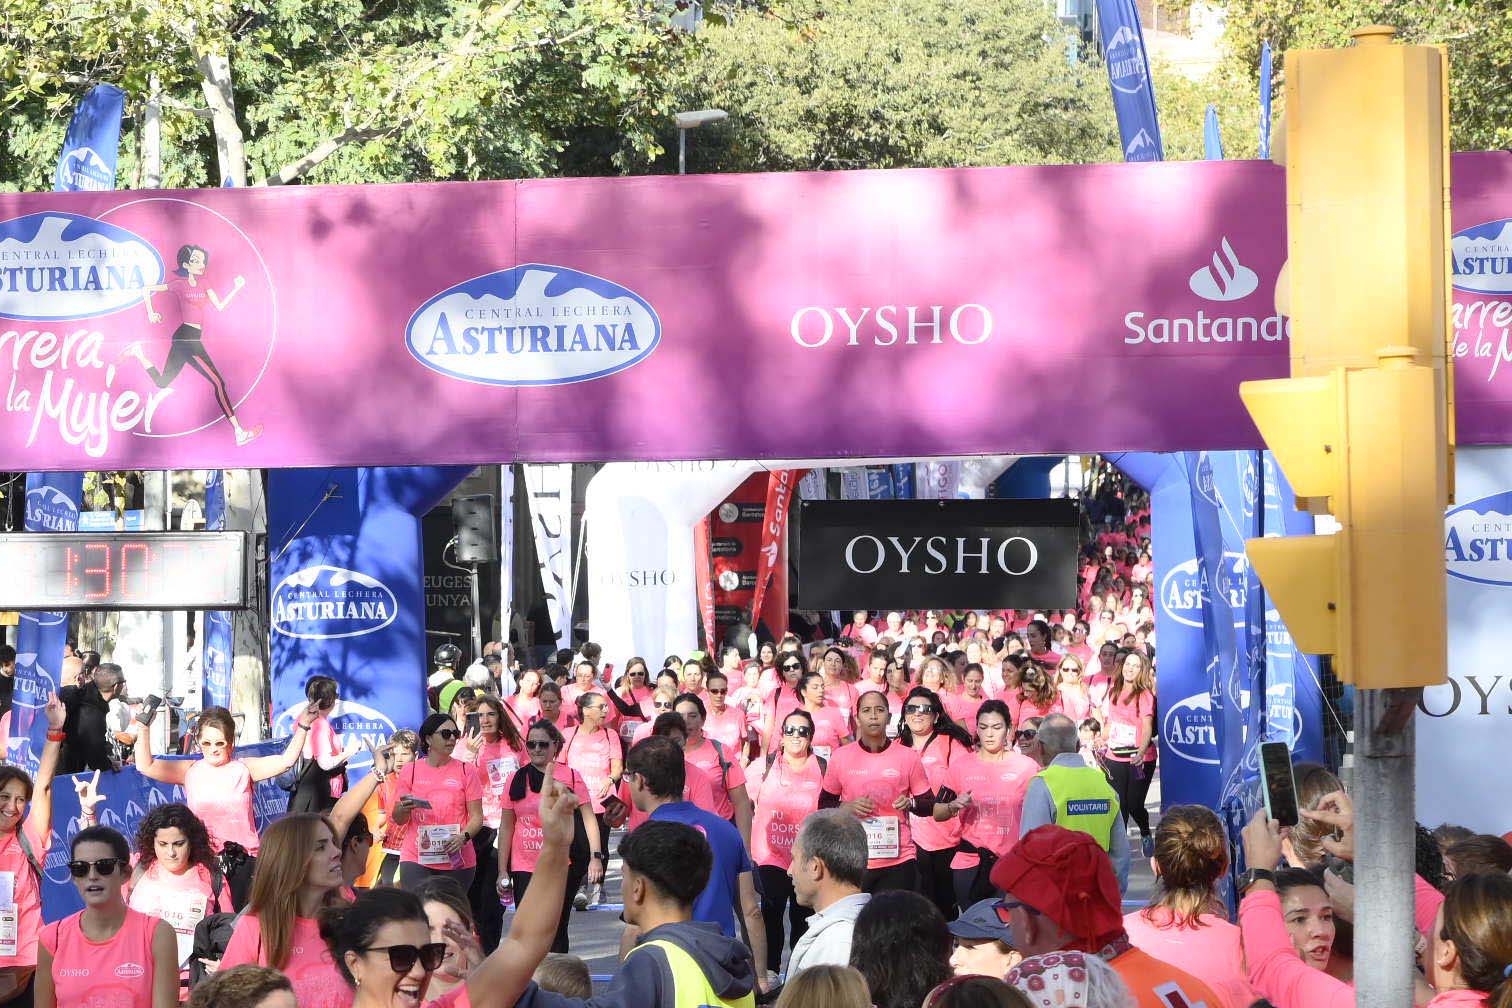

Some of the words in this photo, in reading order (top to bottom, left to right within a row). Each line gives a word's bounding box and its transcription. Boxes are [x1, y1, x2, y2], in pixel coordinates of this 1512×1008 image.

[465, 305, 542, 319] CENTRAL
[552, 303, 632, 317] LECHERA
[426, 311, 640, 356] ASTURIANA
[791, 303, 993, 347] OYSHO
[1475, 330, 1492, 357] la
[6, 374, 31, 412] la
[25, 362, 176, 458] Mujer
[845, 535, 1038, 576] OYSHO
[276, 595, 388, 622] ASTURIANA
[335, 722, 384, 730] LECHERA
[1068, 803, 1109, 812] VOLUNTARIS
